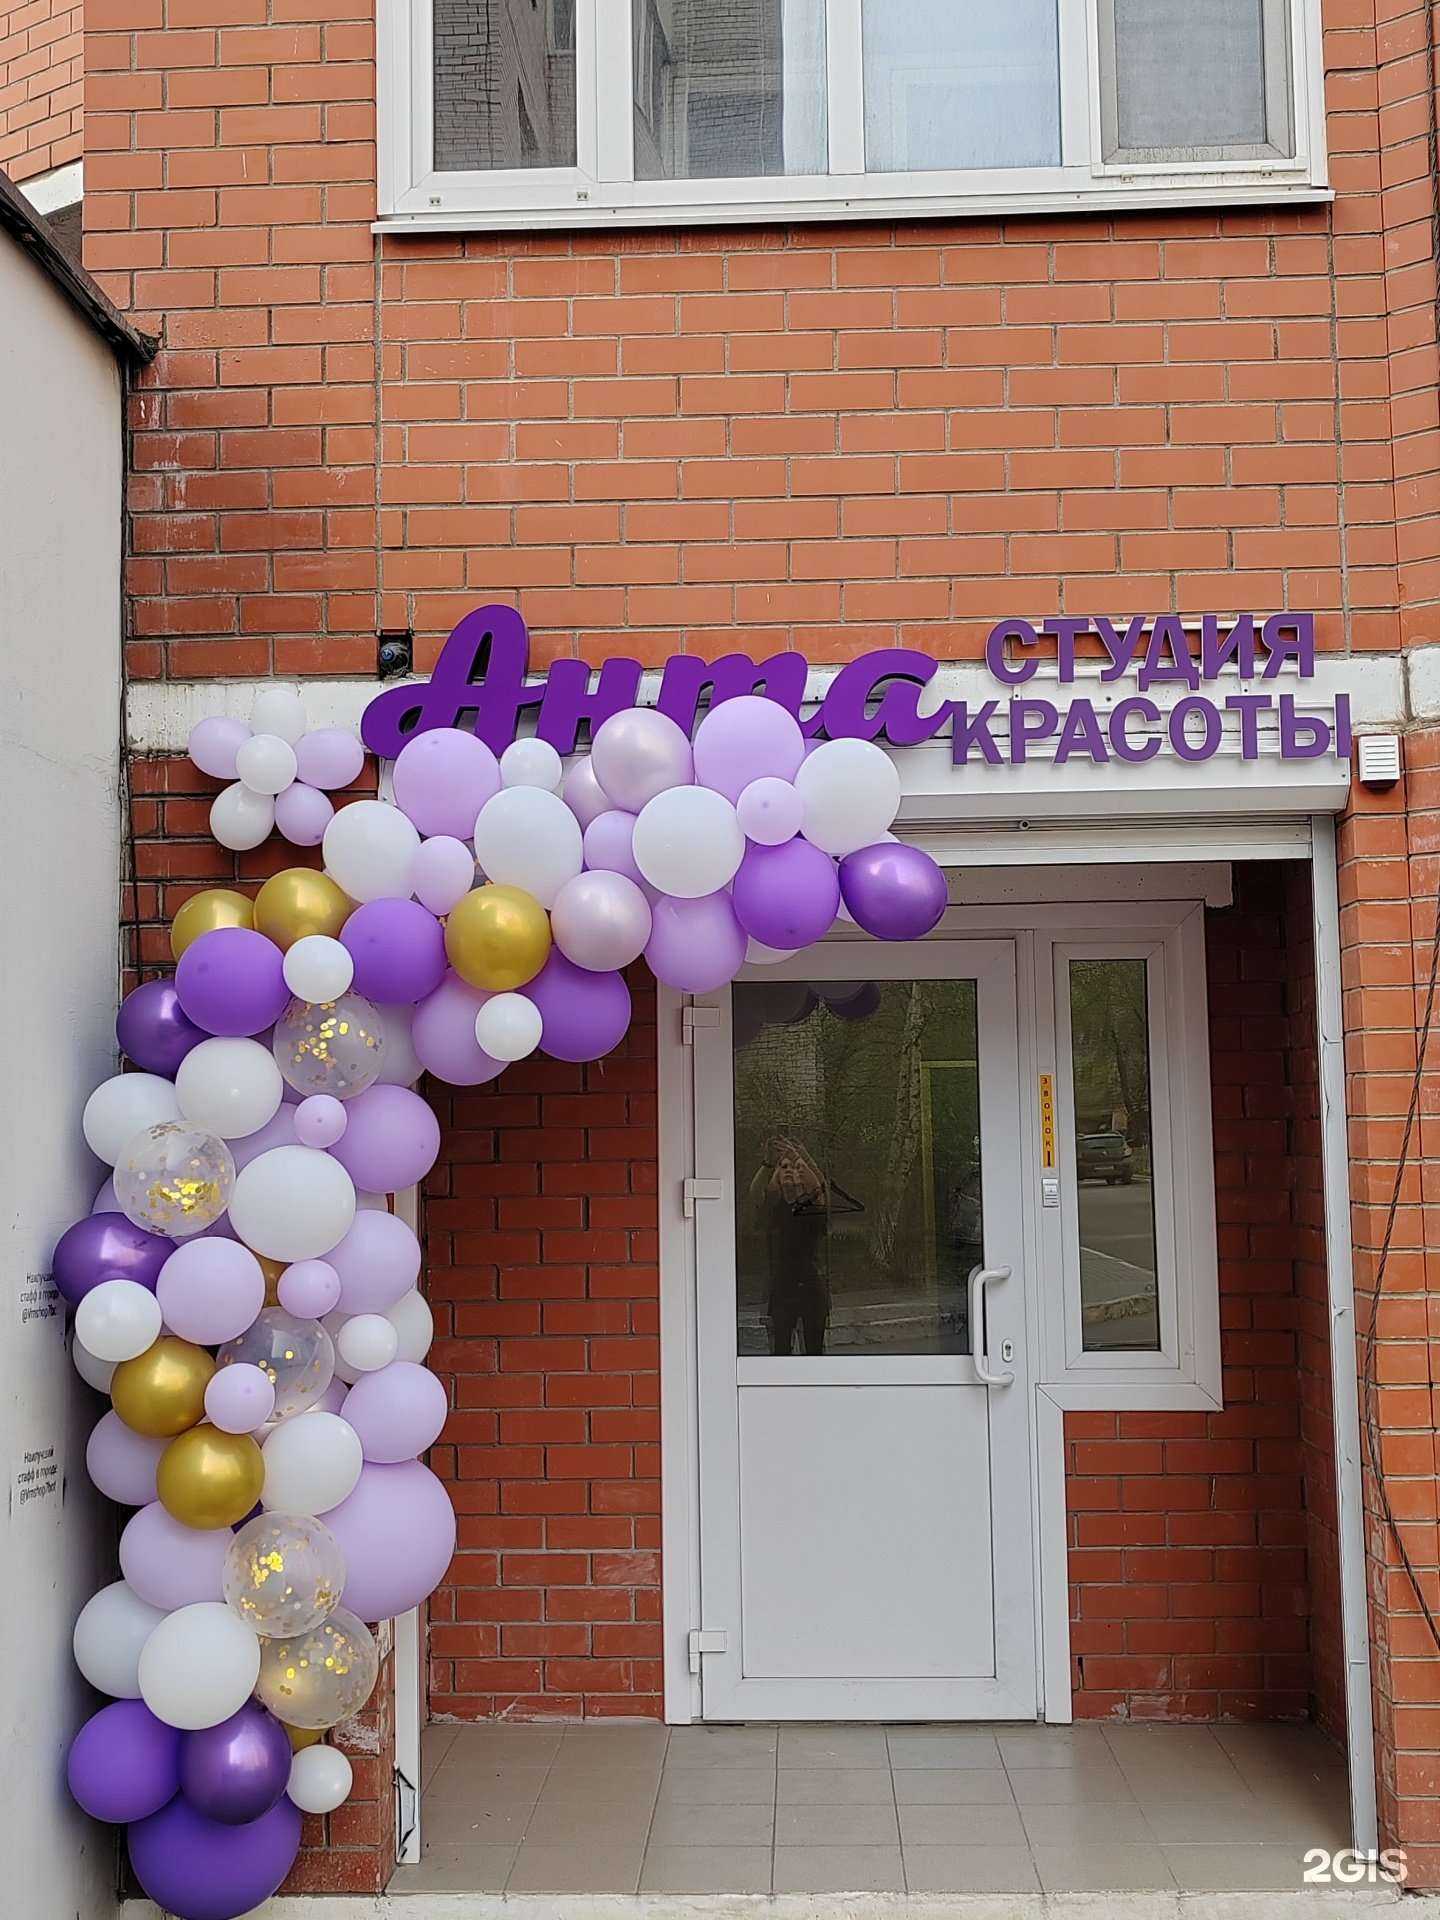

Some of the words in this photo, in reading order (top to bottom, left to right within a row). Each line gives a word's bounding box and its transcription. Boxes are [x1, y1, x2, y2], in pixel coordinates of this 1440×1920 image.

[986, 613, 1315, 692] СТУДИЯ
[951, 693, 1351, 766] КРАСОТЫ
[1040, 1077, 1051, 1147] ЗВОНОК
